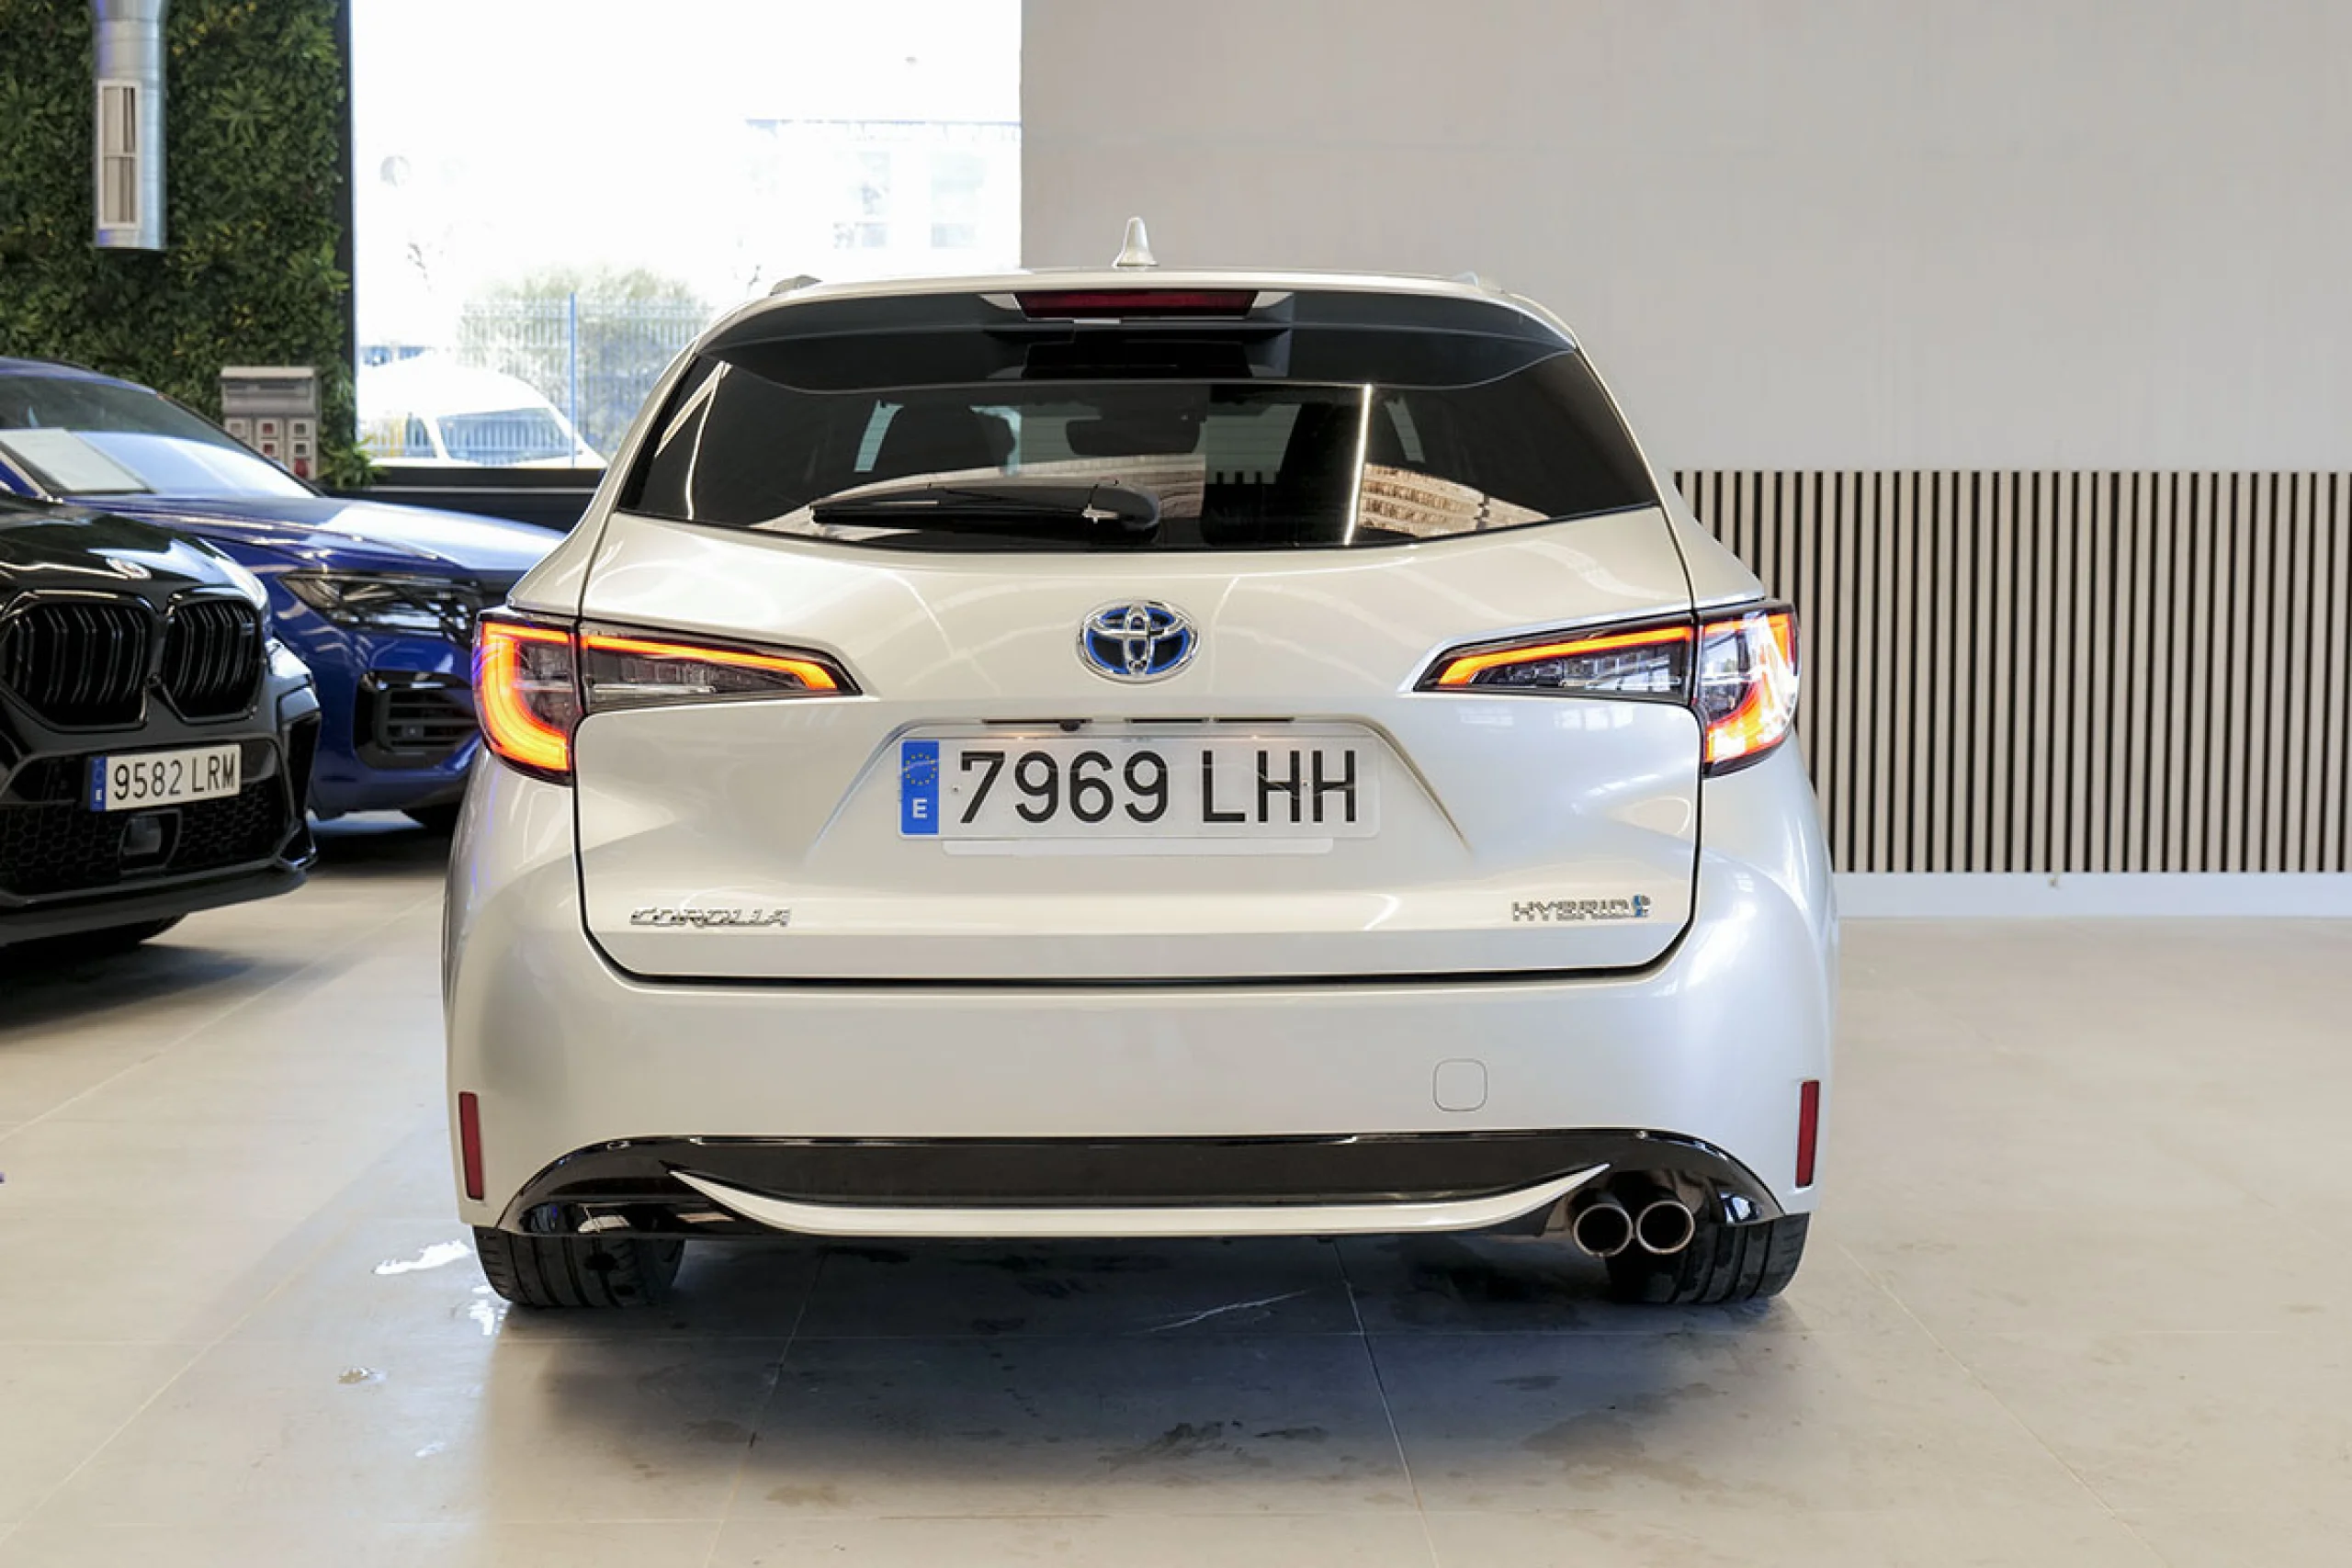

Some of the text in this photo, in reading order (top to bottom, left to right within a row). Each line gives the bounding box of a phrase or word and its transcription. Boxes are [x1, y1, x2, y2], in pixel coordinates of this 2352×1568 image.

[114, 752, 235, 800] 9582 LRM
[960, 750, 1356, 823] 7969 LHH
[912, 798, 927, 818] E
[630, 908, 790, 928] COROLLA
[1512, 899, 1629, 921] HYBRID
